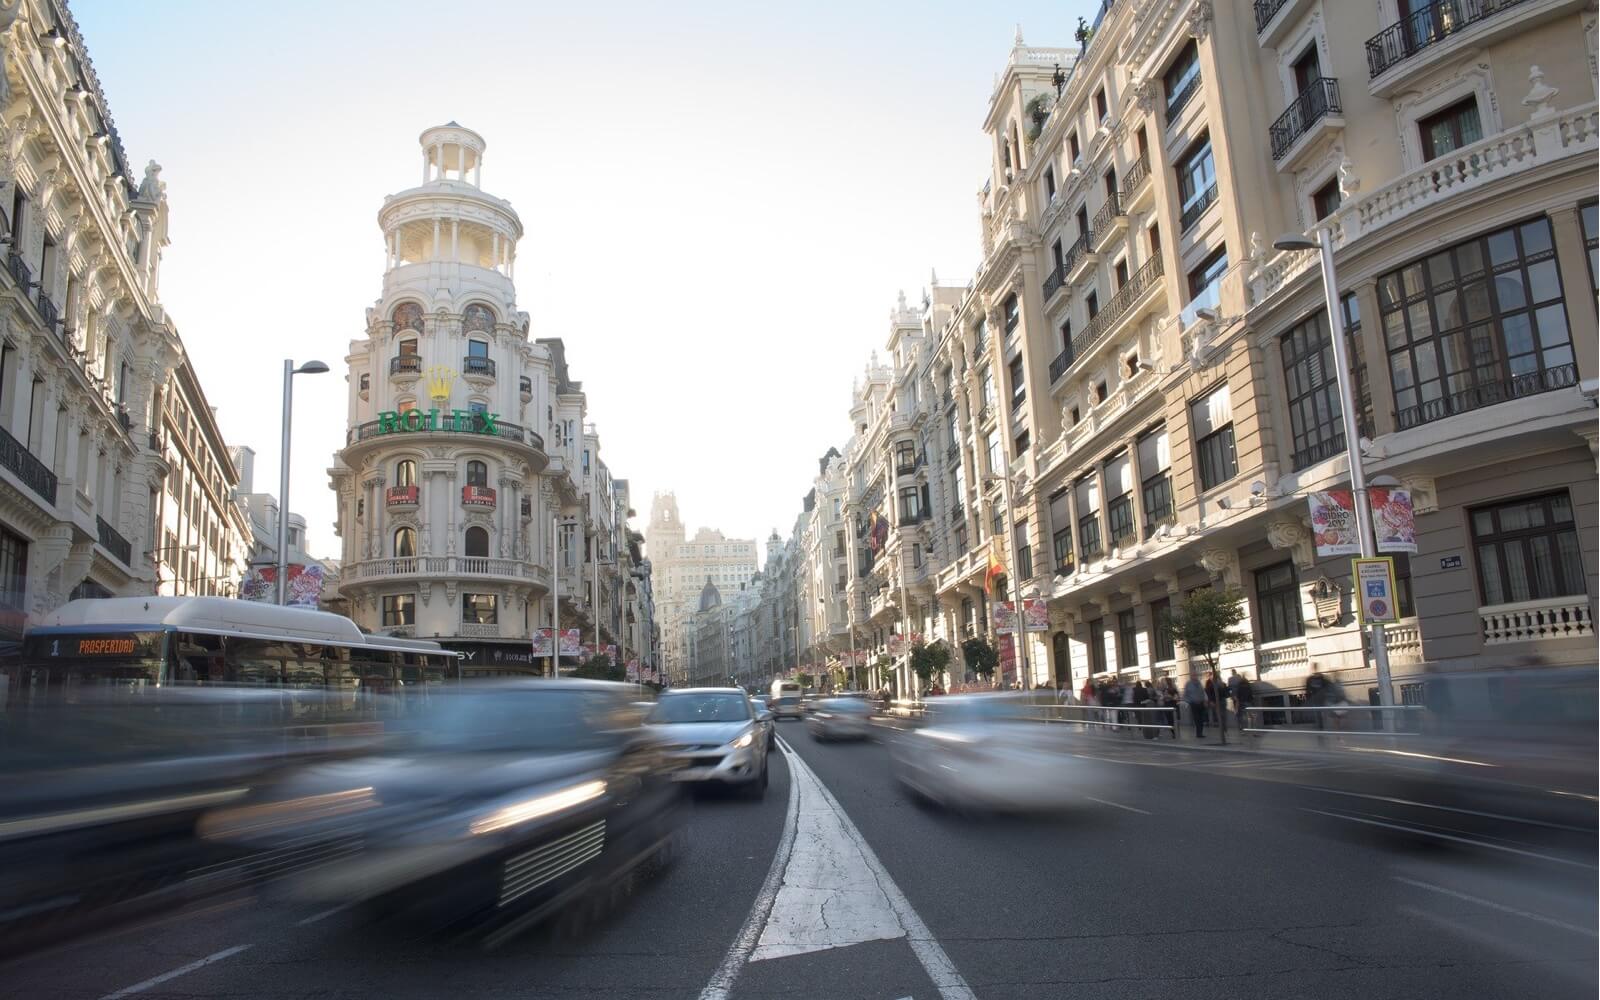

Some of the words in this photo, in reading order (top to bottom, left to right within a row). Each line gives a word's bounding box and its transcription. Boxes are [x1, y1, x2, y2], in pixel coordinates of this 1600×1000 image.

[377, 408, 500, 436] ROLEX
[51, 640, 59, 656] 1
[79, 640, 135, 654] PROSPERIDAD
